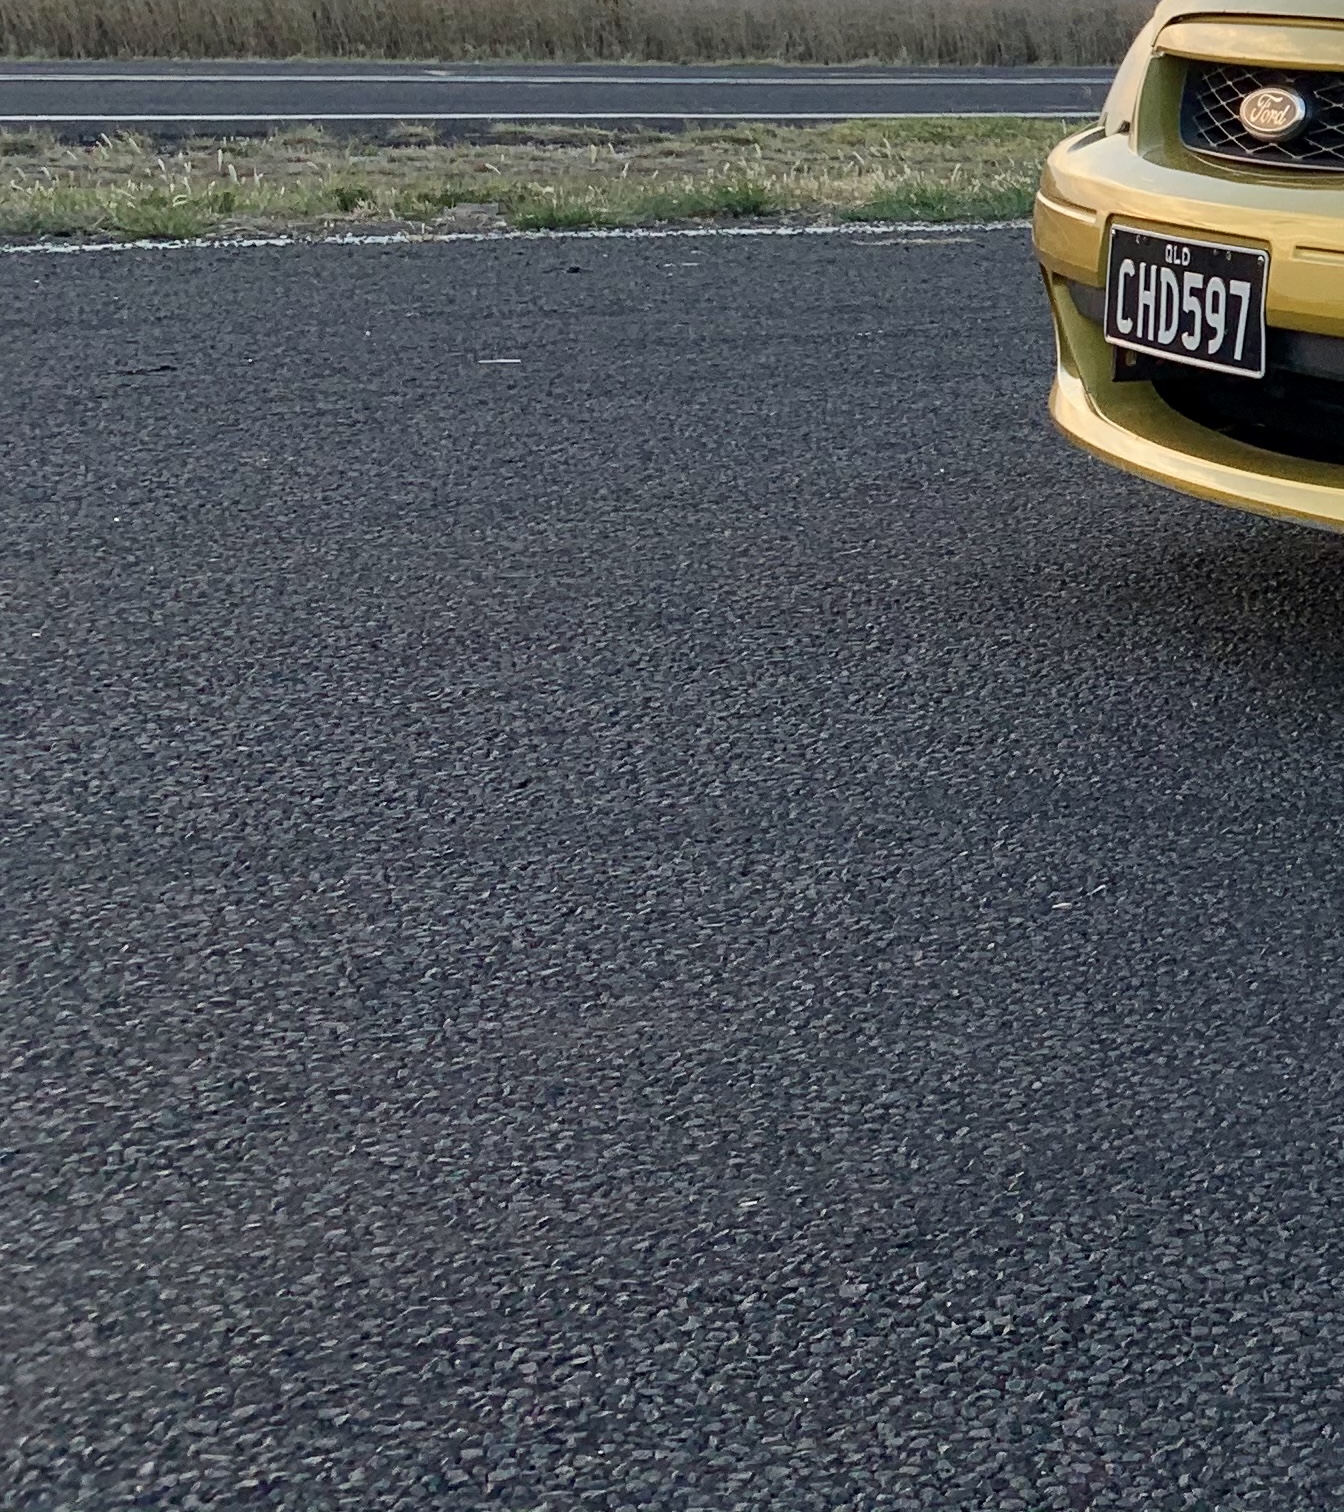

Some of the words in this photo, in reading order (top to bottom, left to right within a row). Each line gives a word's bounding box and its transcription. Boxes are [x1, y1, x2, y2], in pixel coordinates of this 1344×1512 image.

[1250, 93, 1290, 125] Ford
[1165, 244, 1191, 267] QLD
[1116, 258, 1251, 361] CHD597
